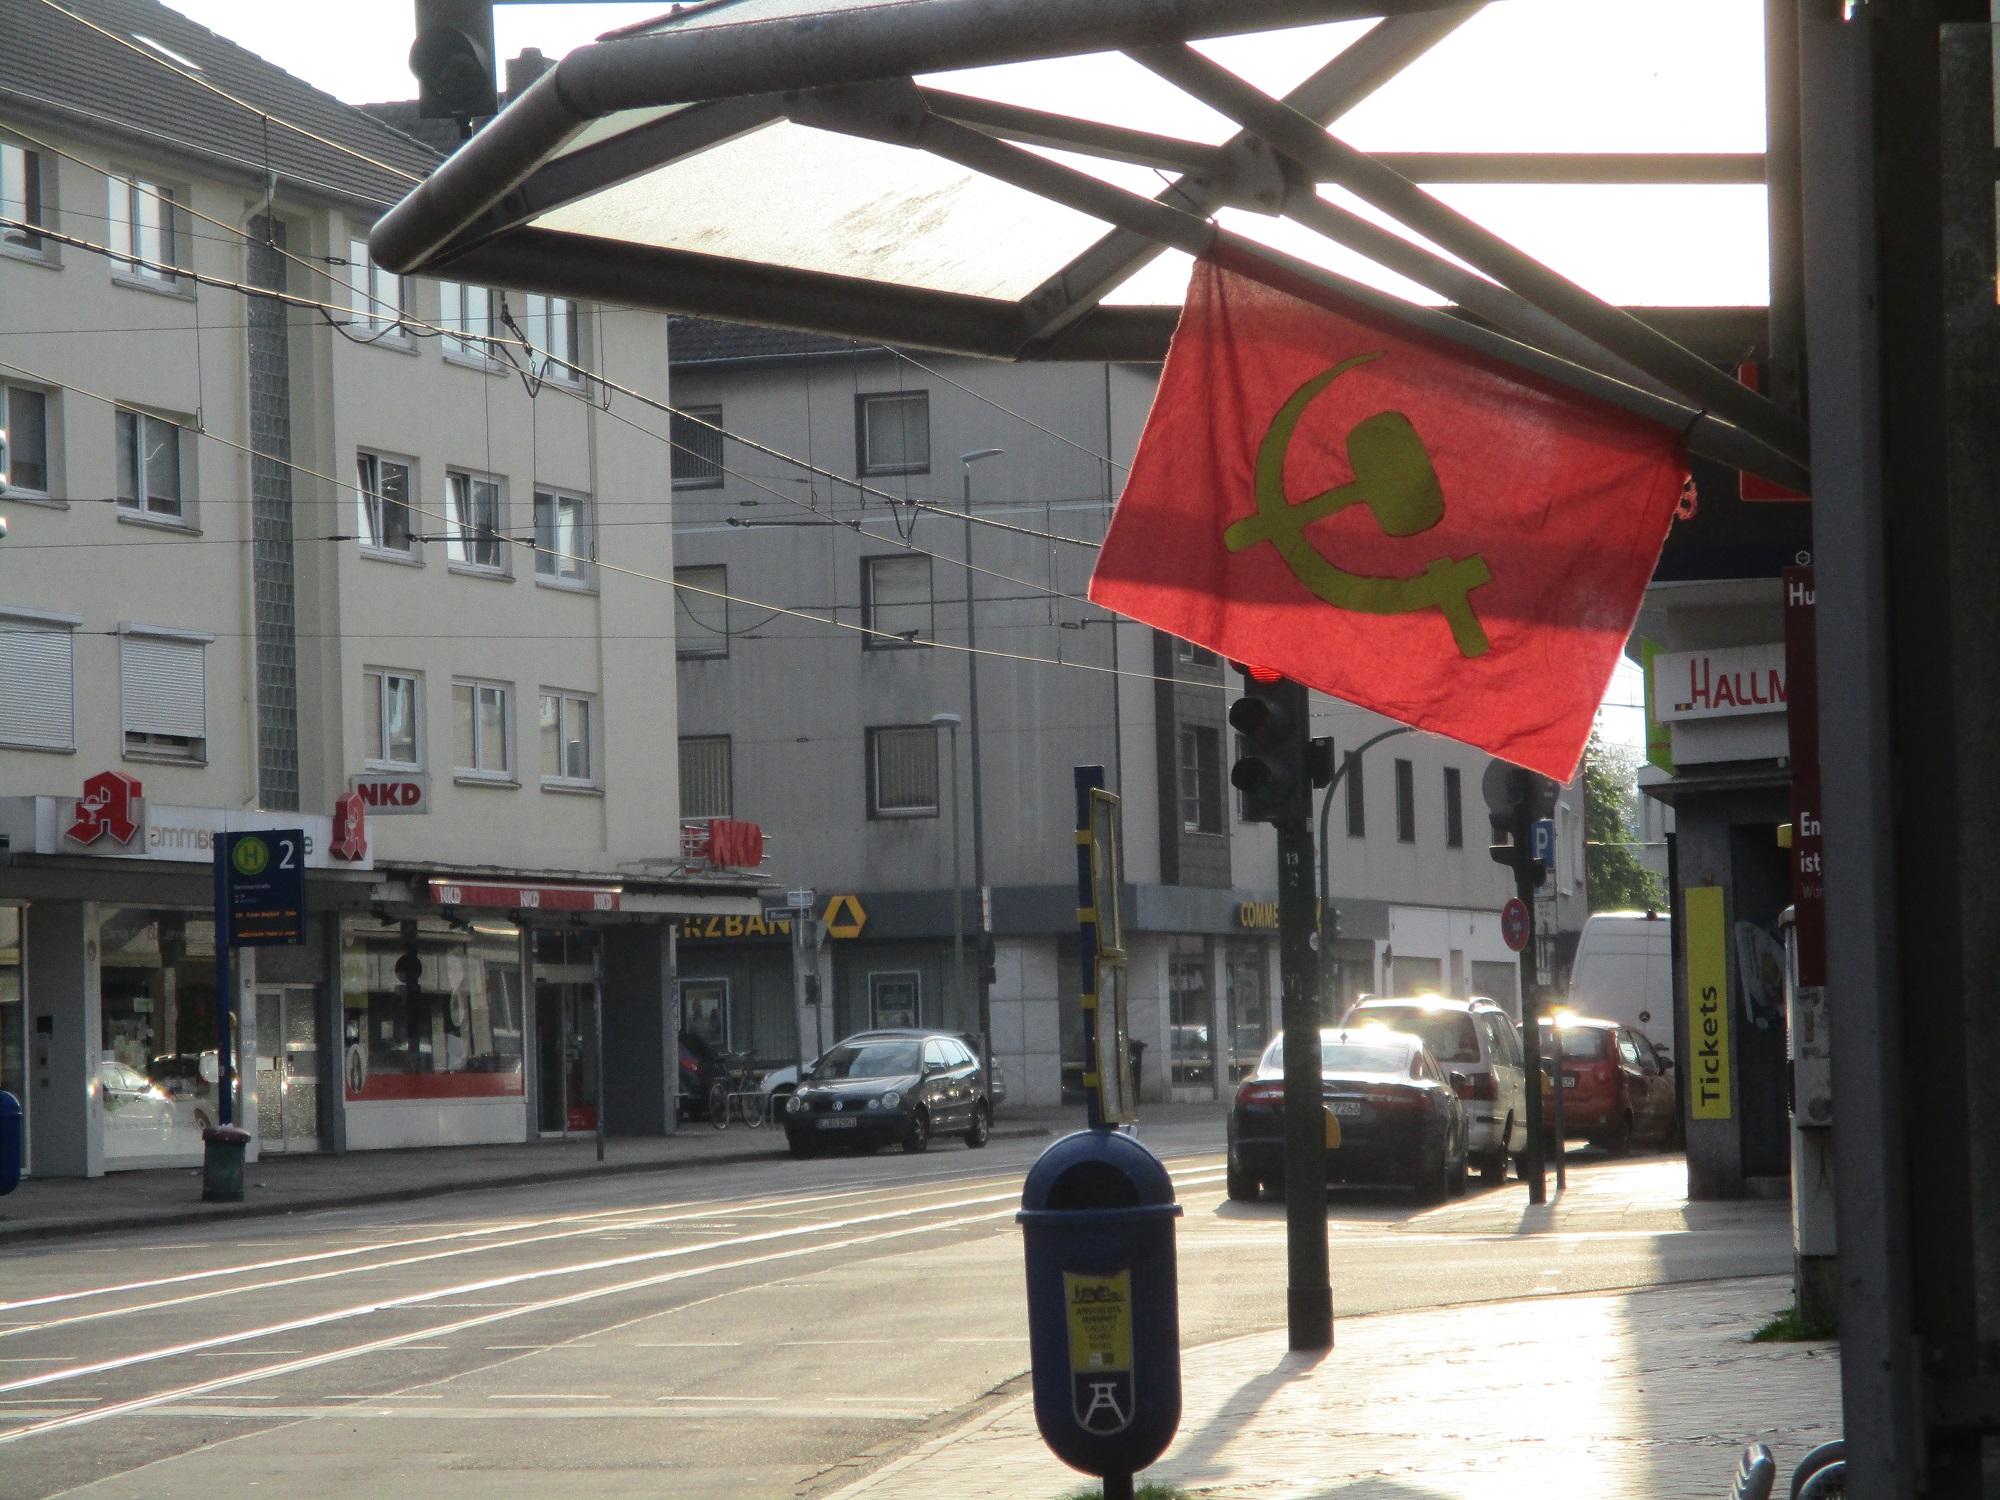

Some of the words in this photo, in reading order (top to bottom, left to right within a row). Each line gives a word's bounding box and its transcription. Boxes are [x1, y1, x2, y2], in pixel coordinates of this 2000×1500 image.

[358, 783, 421, 806] NKD
[279, 839, 295, 869] 2
[713, 820, 762, 867] NKD
[439, 886, 462, 904] NKD
[520, 890, 540, 908] NKD
[593, 893, 612, 910] NKD
[1699, 985, 1720, 1107] Tickets
